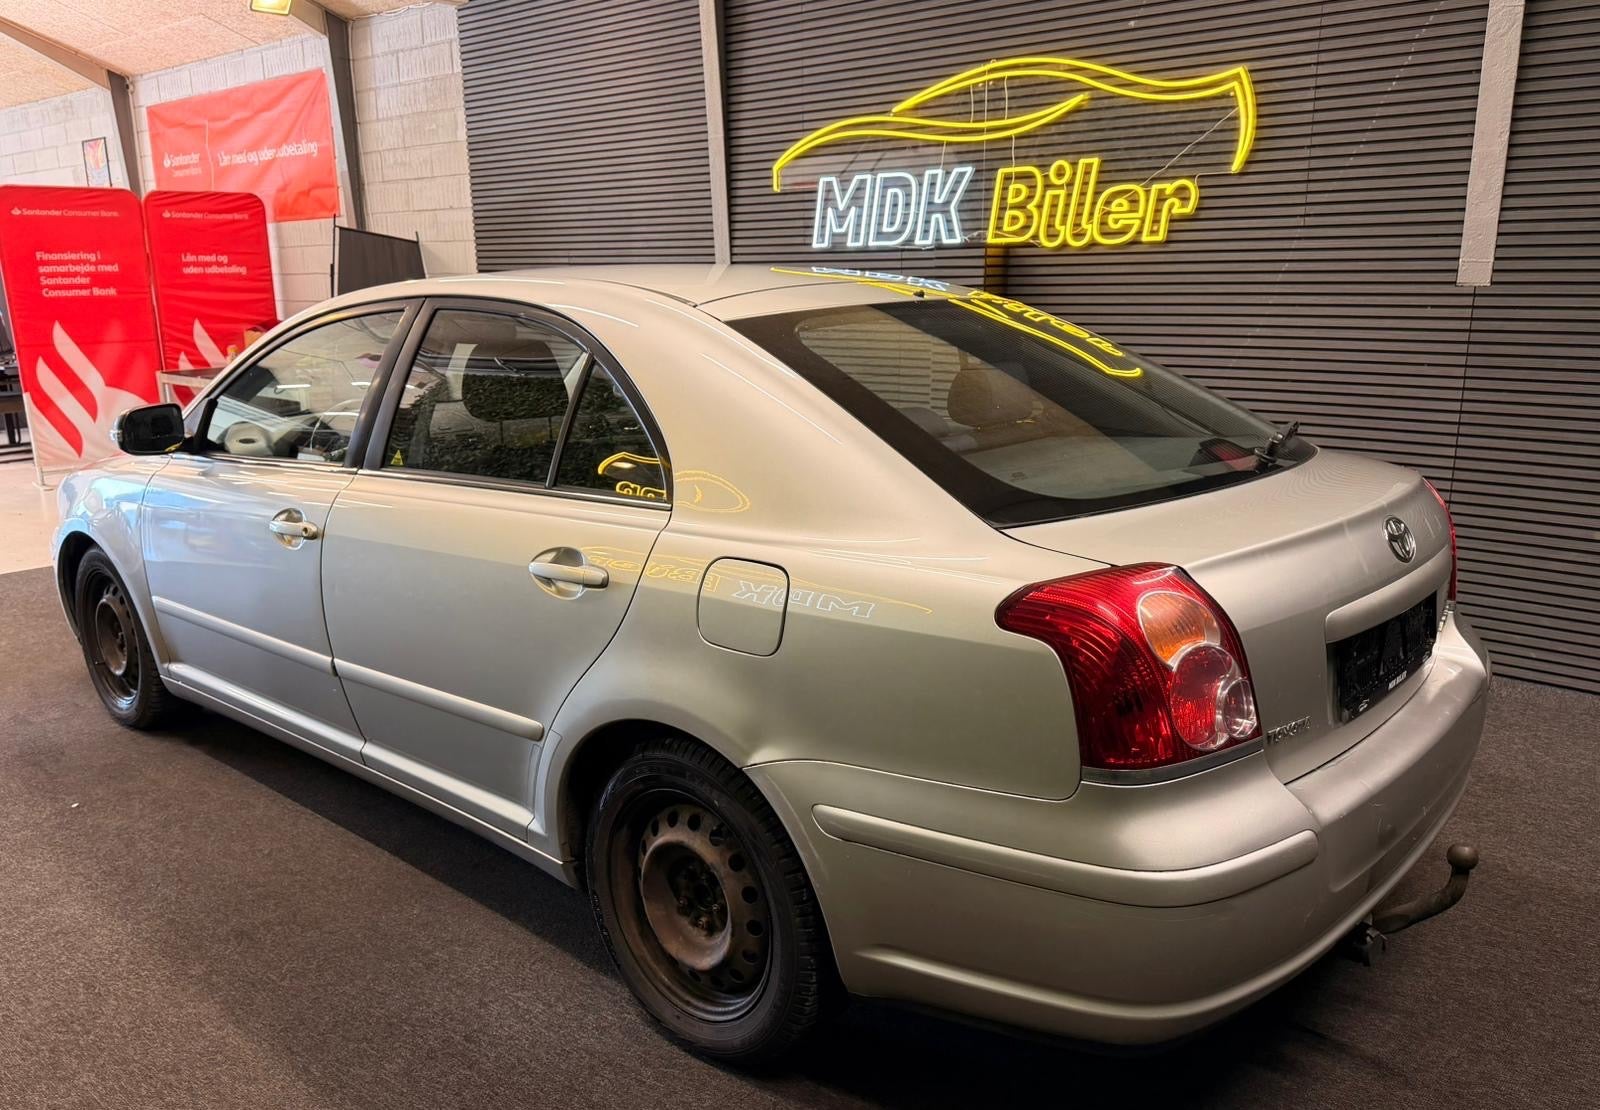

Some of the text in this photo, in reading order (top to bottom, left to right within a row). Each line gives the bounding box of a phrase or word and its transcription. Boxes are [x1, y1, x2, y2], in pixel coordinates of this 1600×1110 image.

[812, 157, 1199, 249] MDK Biler
[22, 207, 61, 216] Santander
[62, 208, 100, 217] Consumer
[35, 251, 97, 262] Finansiering
[181, 253, 228, 265] Lån med og
[38, 263, 119, 274] samarbejde med
[183, 265, 247, 276] uden udbetaling
[40, 276, 91, 286] Santander
[42, 287, 117, 297] Consumer Bank
